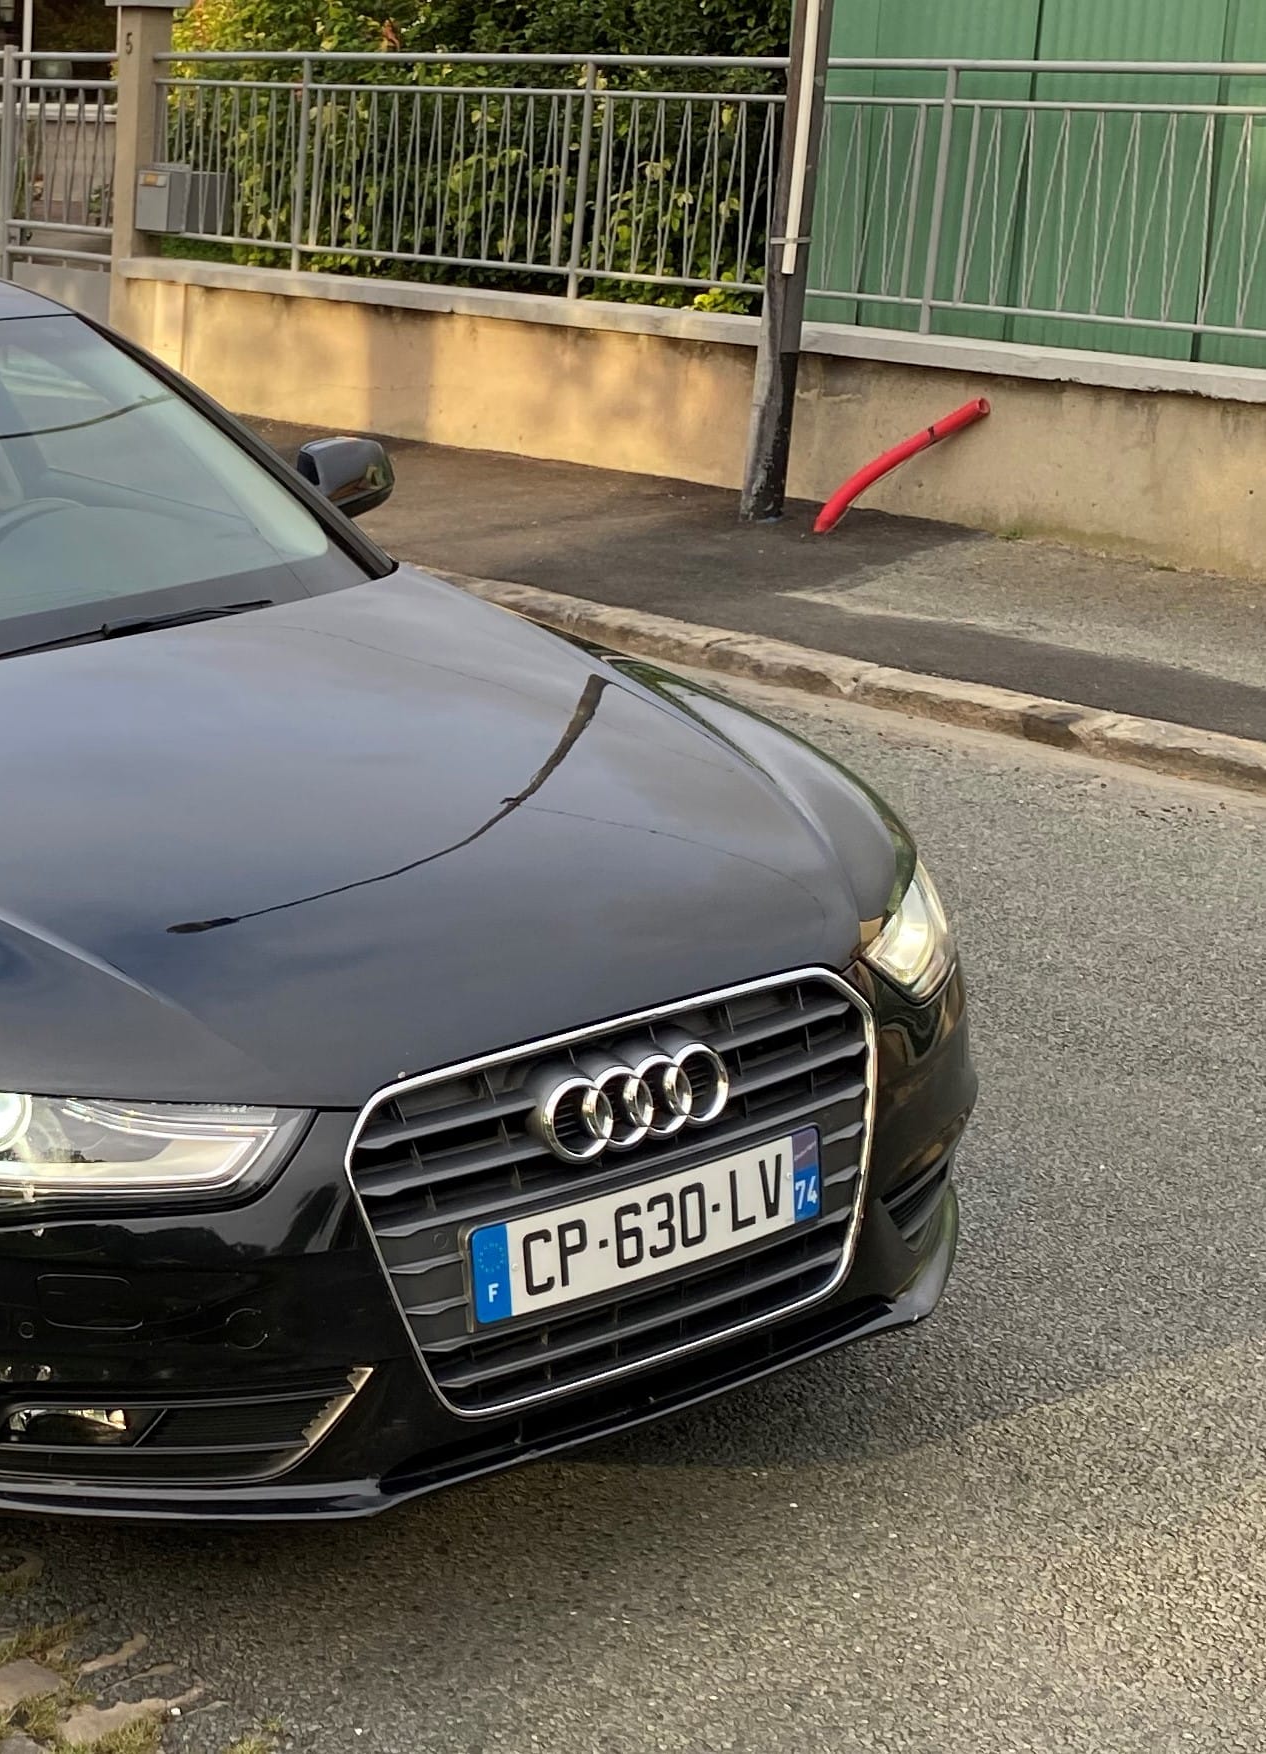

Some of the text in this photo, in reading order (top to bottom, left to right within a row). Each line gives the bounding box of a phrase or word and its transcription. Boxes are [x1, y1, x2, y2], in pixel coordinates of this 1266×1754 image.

[125, 31, 133, 55] 5
[795, 1175, 818, 1210] 74
[522, 1153, 782, 1296] CP-630-LV
[488, 1283, 499, 1303] F
